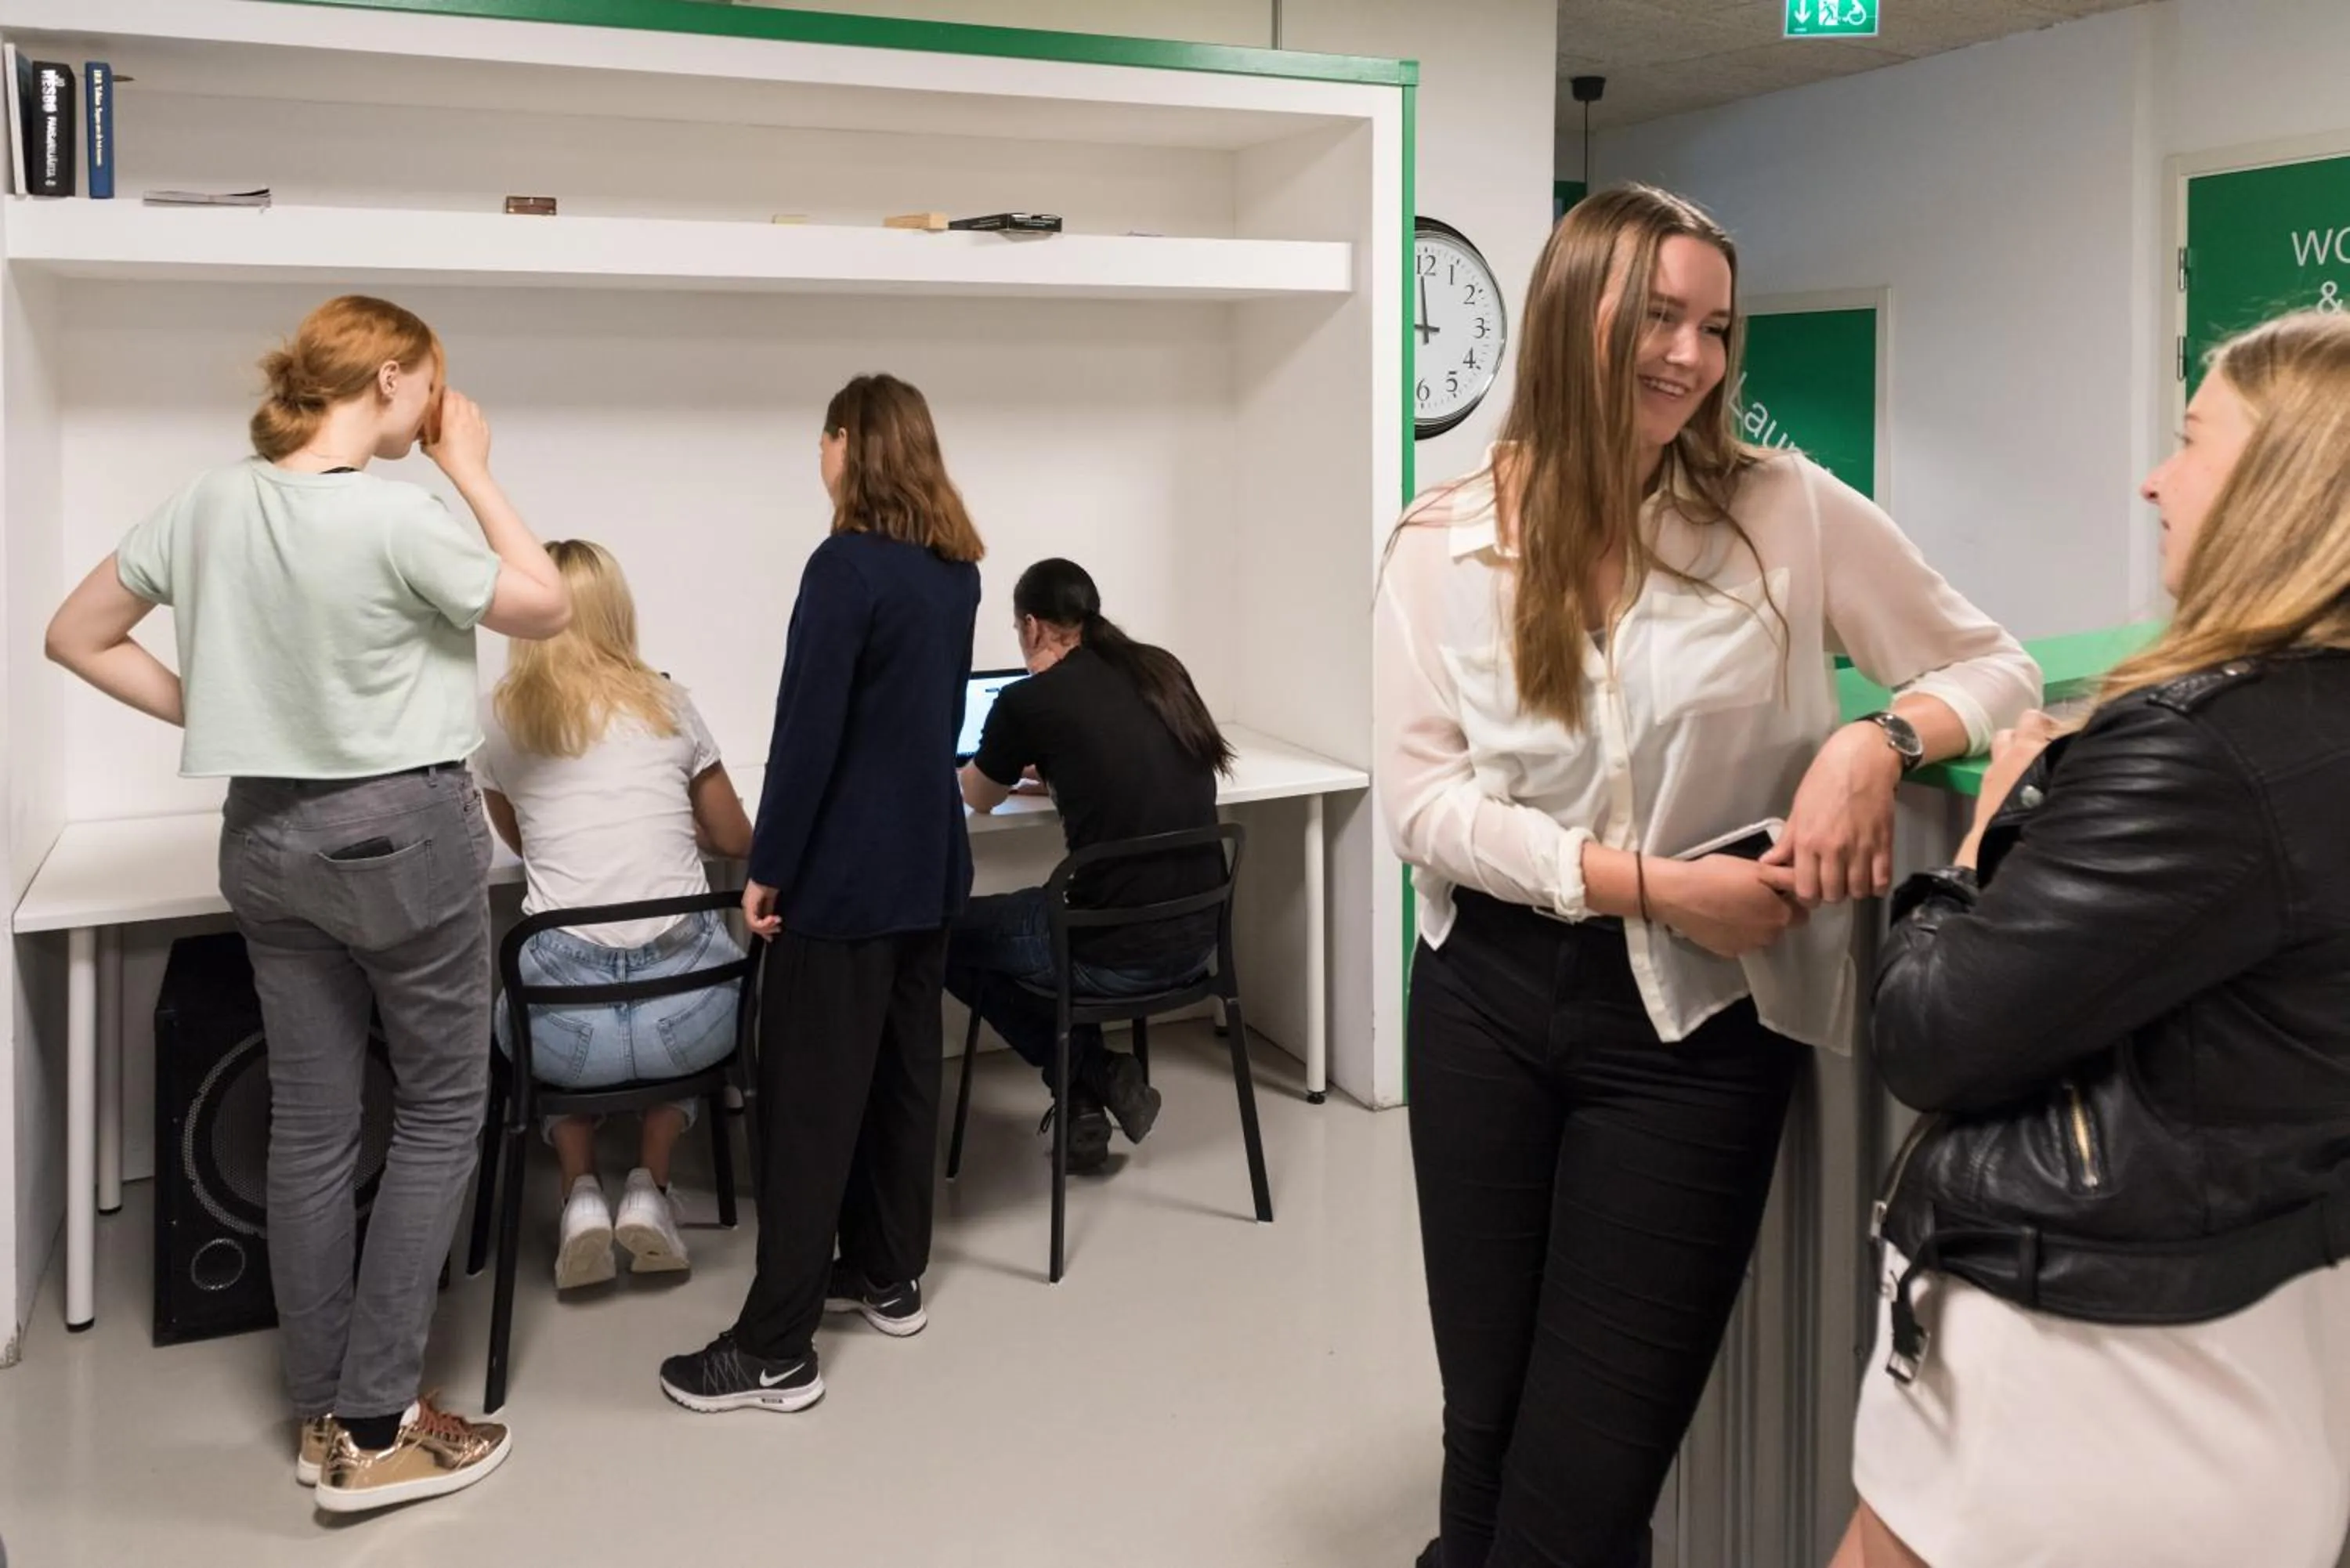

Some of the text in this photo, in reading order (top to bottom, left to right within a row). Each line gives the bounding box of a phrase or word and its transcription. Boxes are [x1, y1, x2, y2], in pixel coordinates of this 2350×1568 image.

[1416, 254, 1437, 276] 12
[1448, 264, 1455, 286] 1
[1463, 284, 1476, 305] 2
[2317, 280, 2344, 314] &
[1473, 317, 1485, 338] 3
[1462, 347, 1476, 369] 4
[1416, 378, 1430, 401] 6
[1446, 370, 1458, 392] 5
